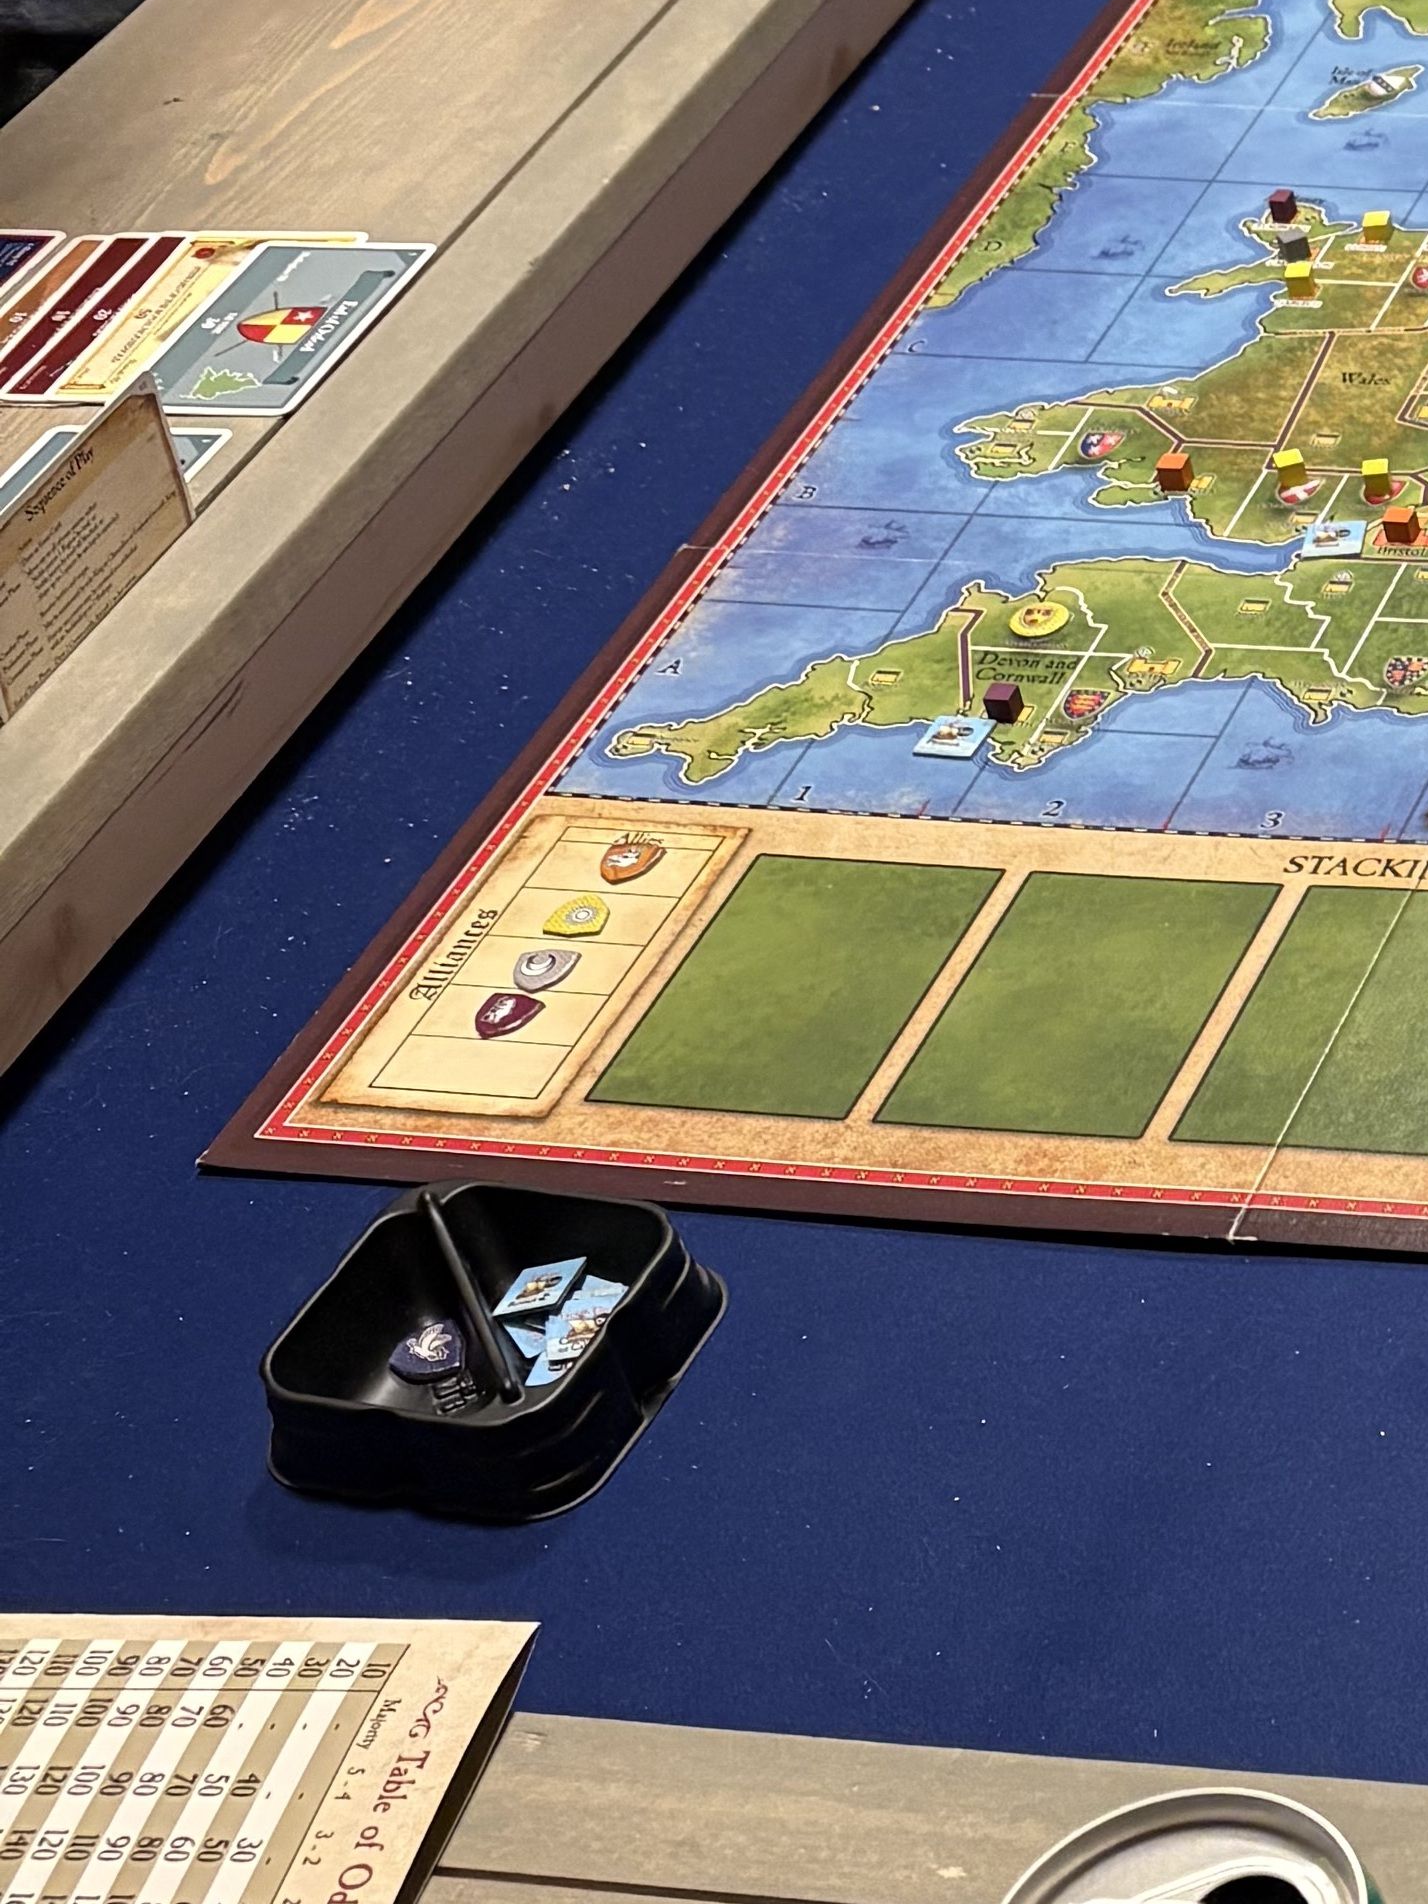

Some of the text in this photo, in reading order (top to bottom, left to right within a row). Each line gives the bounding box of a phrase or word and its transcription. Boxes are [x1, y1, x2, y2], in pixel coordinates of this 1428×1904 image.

[1341, 373, 1392, 387] Wales
[796, 486, 817, 500] B
[657, 658, 683, 676] A
[978, 651, 1079, 671] Devon and
[976, 667, 1067, 686] Cornwall
[794, 785, 812, 802] 1
[1042, 800, 1064, 818] 2
[1260, 811, 1284, 830] 3
[409, 908, 499, 1001] Alliances
[233, 1656, 266, 1678] 50
[265, 1656, 296, 1678] 40
[297, 1656, 330, 1679] 30
[329, 1657, 361, 1679] 20
[361, 1662, 391, 1679] 10
[202, 1704, 236, 1729] 60
[355, 1697, 402, 1751] Majority
[163, 1772, 199, 1797] 70
[196, 1772, 230, 1797] 50
[230, 1772, 261, 1797] 40
[371, 1749, 431, 1814] Table
[129, 1836, 165, 1863] 80
[163, 1836, 196, 1864] 60
[354, 1825, 385, 1852] of
[196, 1837, 230, 1864] 50
[230, 1837, 263, 1864] 30
